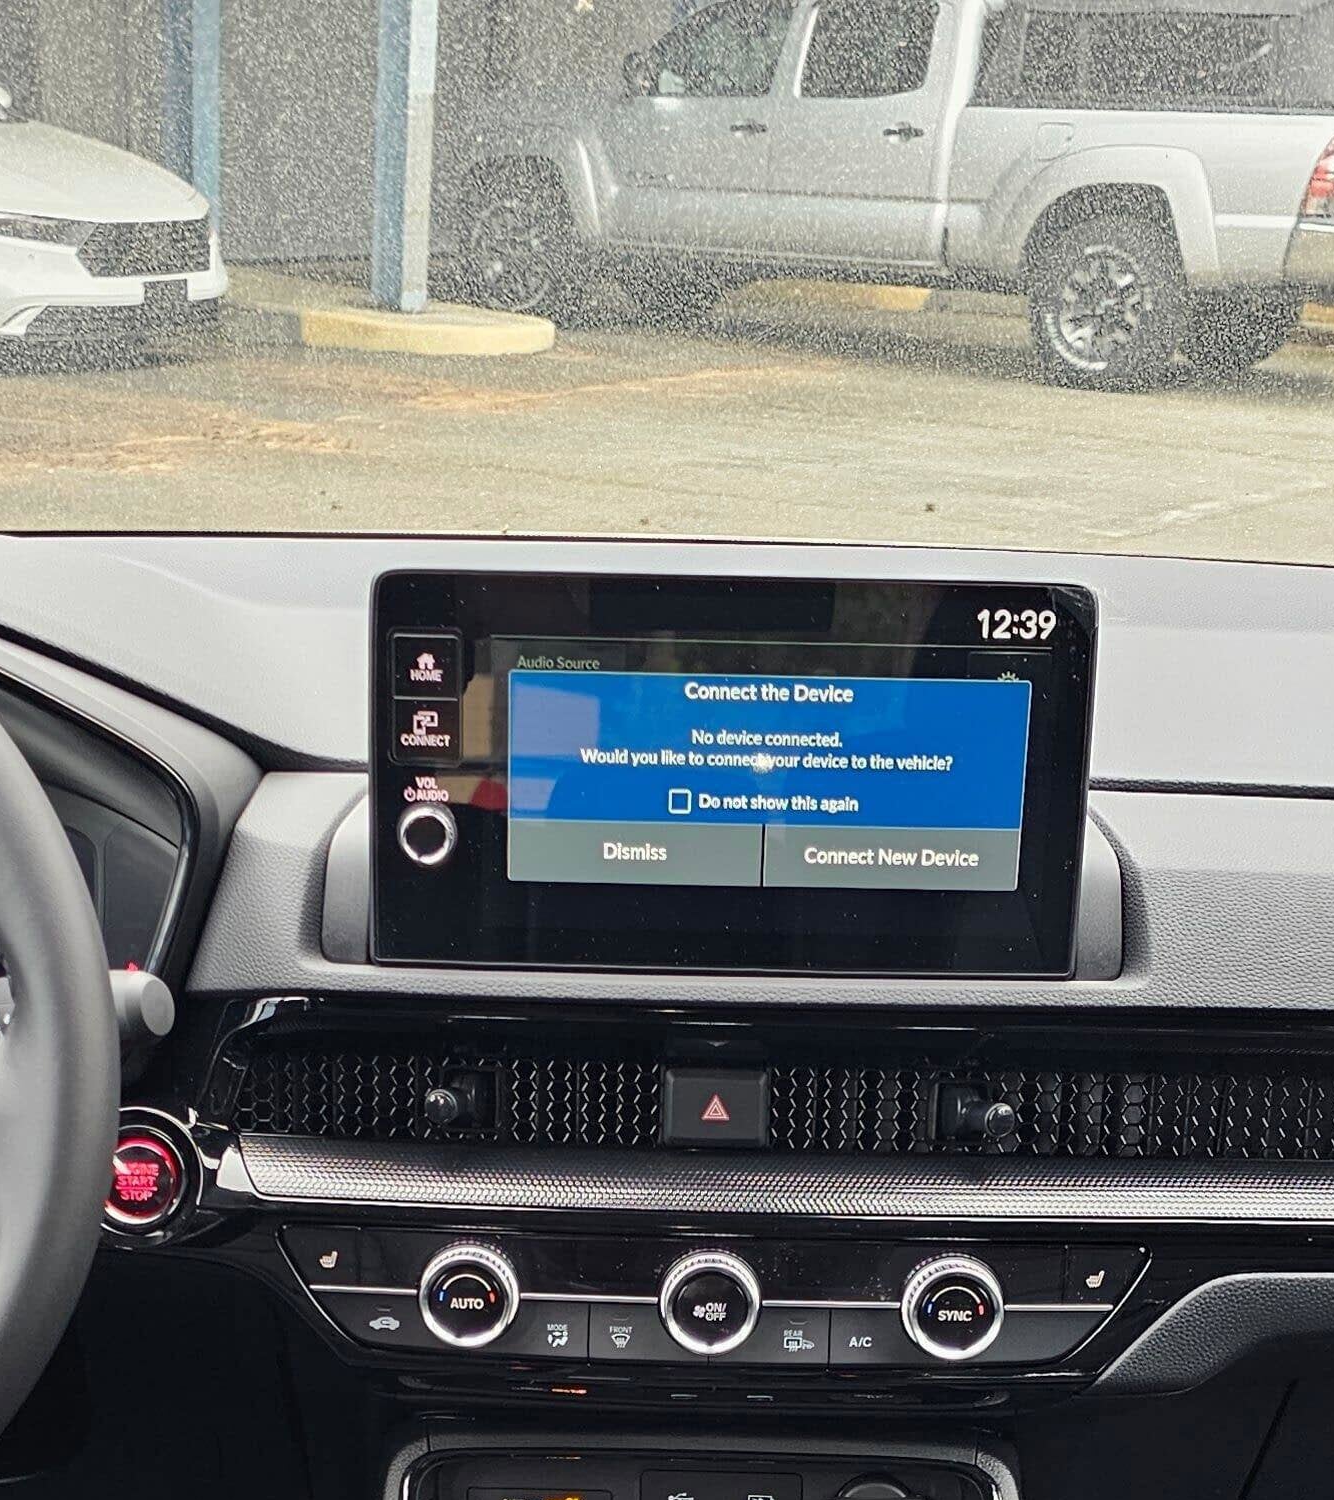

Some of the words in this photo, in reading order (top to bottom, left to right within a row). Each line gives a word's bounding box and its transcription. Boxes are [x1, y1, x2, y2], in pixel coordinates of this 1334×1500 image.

[977, 609, 1057, 640] 12:39
[517, 656, 554, 669] Audio
[557, 657, 600, 670] Source
[410, 669, 443, 682] HOME
[684, 682, 757, 700] Connect
[761, 684, 790, 701] the
[794, 685, 854, 703] Device
[400, 733, 451, 747] CONNECT
[692, 730, 713, 745] No
[716, 730, 762, 746] device
[765, 732, 843, 748] connected.
[581, 748, 628, 764] Would
[631, 751, 658, 767] you
[661, 750, 685, 765] like
[689, 751, 704, 766] to
[769, 755, 801, 770] your
[803, 754, 848, 769] device
[851, 756, 866, 769] to
[870, 755, 894, 770] the
[896, 755, 953, 771] vehicle?
[415, 776, 438, 789] VOL
[417, 790, 449, 802] AUDIO
[698, 794, 719, 808] Do
[723, 795, 748, 809] not
[750, 795, 788, 810] show
[791, 795, 818, 811] this
[820, 797, 859, 813] again
[603, 842, 667, 861] Dismiss
[804, 847, 872, 865] Connect
[878, 849, 917, 866] New
[921, 850, 979, 867] Device
[115, 1162, 159, 1177] GINE
[117, 1176, 156, 1187] START
[120, 1190, 153, 1201] STOP
[450, 1298, 484, 1310] AUTO
[705, 1303, 727, 1312] ON/
[705, 1312, 727, 1322] OFF
[937, 1310, 972, 1323] SYNC
[609, 1326, 632, 1334] FRONT
[849, 1336, 872, 1347] A/C
